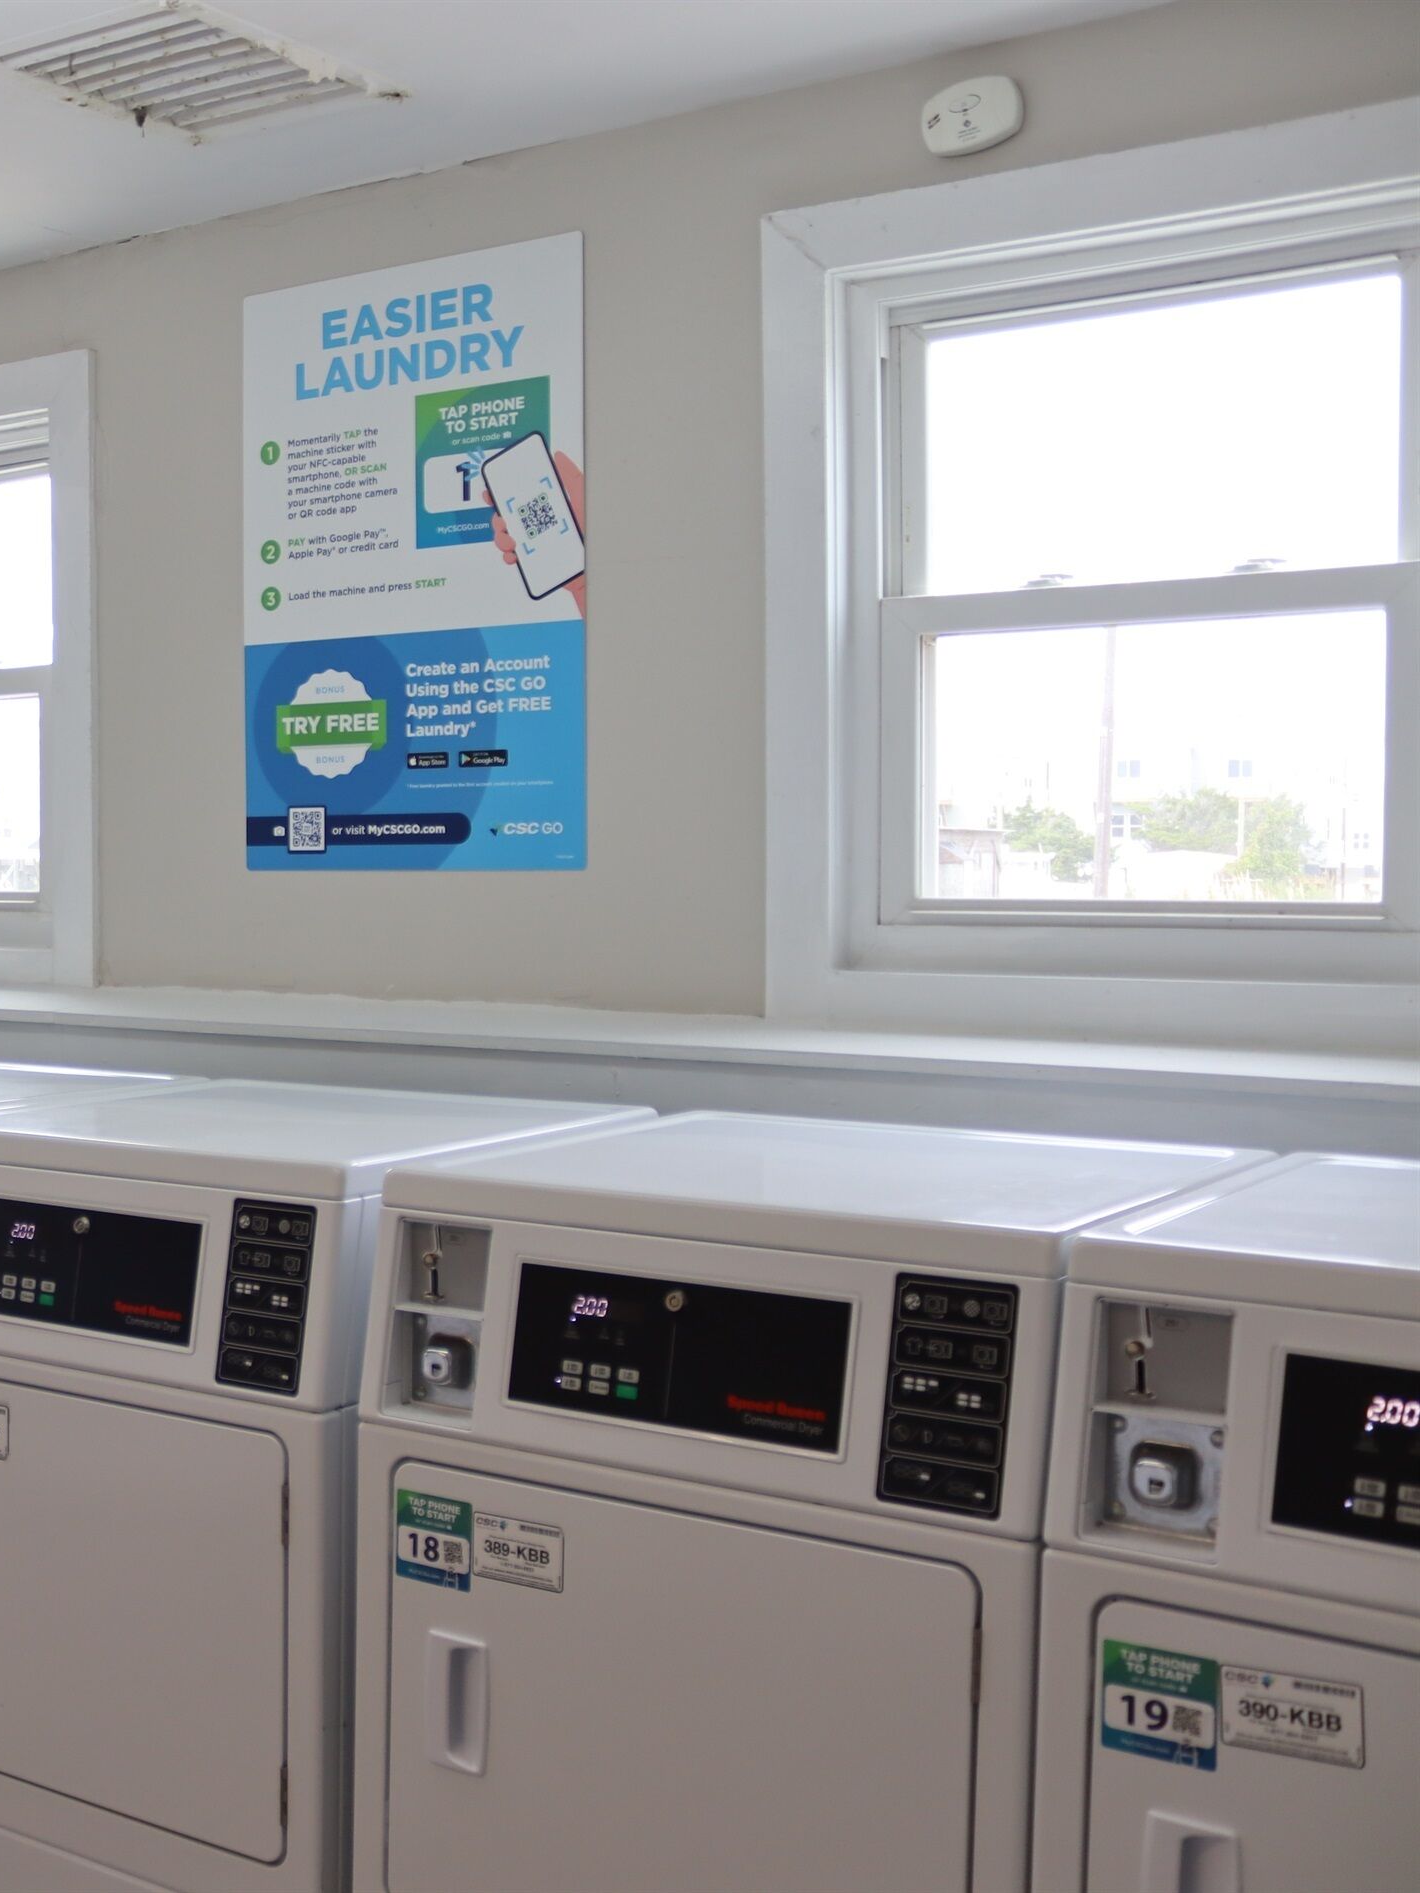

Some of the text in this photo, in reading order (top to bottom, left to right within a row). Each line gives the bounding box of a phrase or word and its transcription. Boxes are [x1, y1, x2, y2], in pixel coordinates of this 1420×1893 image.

[322, 283, 493, 350] EASIER
[295, 325, 525, 401] LAUNDRY
[438, 396, 525, 420] TAP PHONE
[445, 412, 519, 434] TO START
[287, 427, 379, 448] Momentarily TAP the
[452, 433, 501, 446] or scan code
[287, 440, 377, 460] machine sticker with
[287, 463, 387, 484] smartphone, OR SCAN
[288, 454, 366, 473] your NFC-capable
[295, 483, 331, 495] machine
[334, 479, 356, 490] code
[358, 476, 378, 486] with
[288, 487, 398, 510] your smartphone camera
[288, 504, 357, 520] or QR code app
[437, 521, 490, 534] MyCSCGO.com
[288, 531, 361, 547] PAY with Google
[288, 539, 399, 559] Apple or credit card
[288, 577, 447, 601] Load the machine and press START
[405, 655, 550, 677] Create an Account
[316, 685, 345, 695] BONUS
[406, 675, 546, 698] Using the CSC GO
[406, 696, 552, 719] App and Get FREE
[281, 712, 380, 736] TRY FREE
[316, 755, 345, 764] BONUS
[418, 758, 446, 767] App Store
[473, 756, 506, 765] Google Play
[332, 824, 446, 837] or visit MyCSCGO.com
[503, 822, 564, 835] CSC GO
[408, 1497, 461, 1516] TAP PHONE
[413, 1507, 457, 1523] TO START
[475, 1516, 498, 1528] CSC
[408, 1533, 440, 1563] 18
[483, 1539, 551, 1565] 389-KBB
[1120, 1647, 1202, 1675] TAP PHONE
[1126, 1661, 1197, 1684] TO START
[1224, 1671, 1259, 1685] CSC
[1119, 1694, 1169, 1731] 19
[1238, 1699, 1342, 1732] 390-KBB
